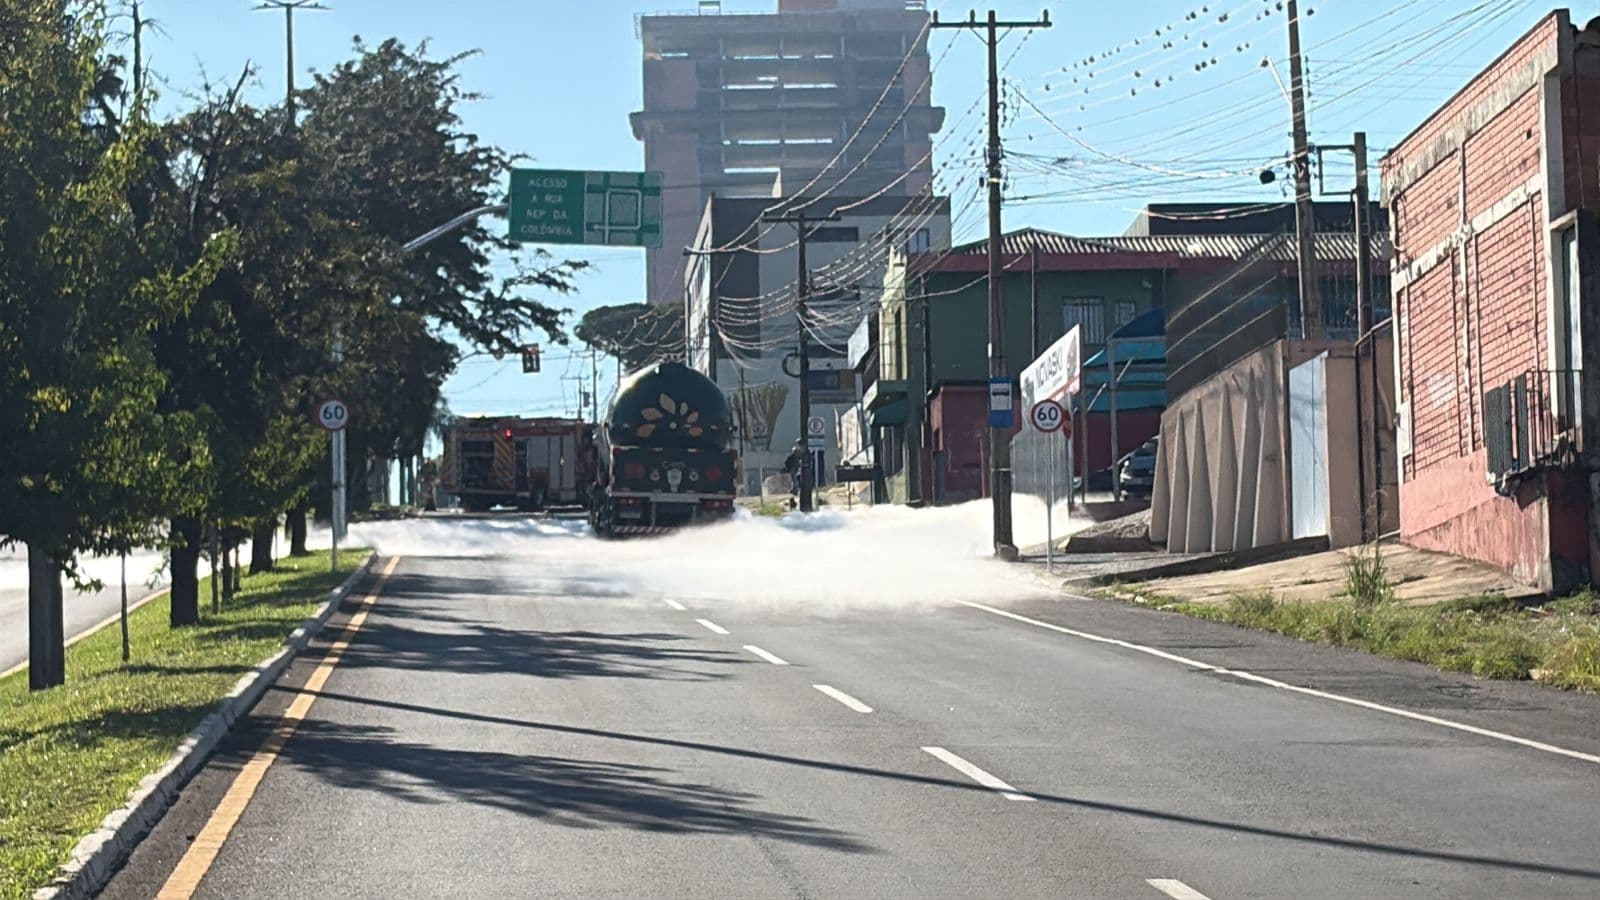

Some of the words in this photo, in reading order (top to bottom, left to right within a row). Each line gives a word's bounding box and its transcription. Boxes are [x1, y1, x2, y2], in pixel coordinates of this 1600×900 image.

[528, 177, 568, 188] ACESSO
[553, 210, 568, 220] DA
[323, 406, 344, 420] 60
[1037, 406, 1058, 421] 60
